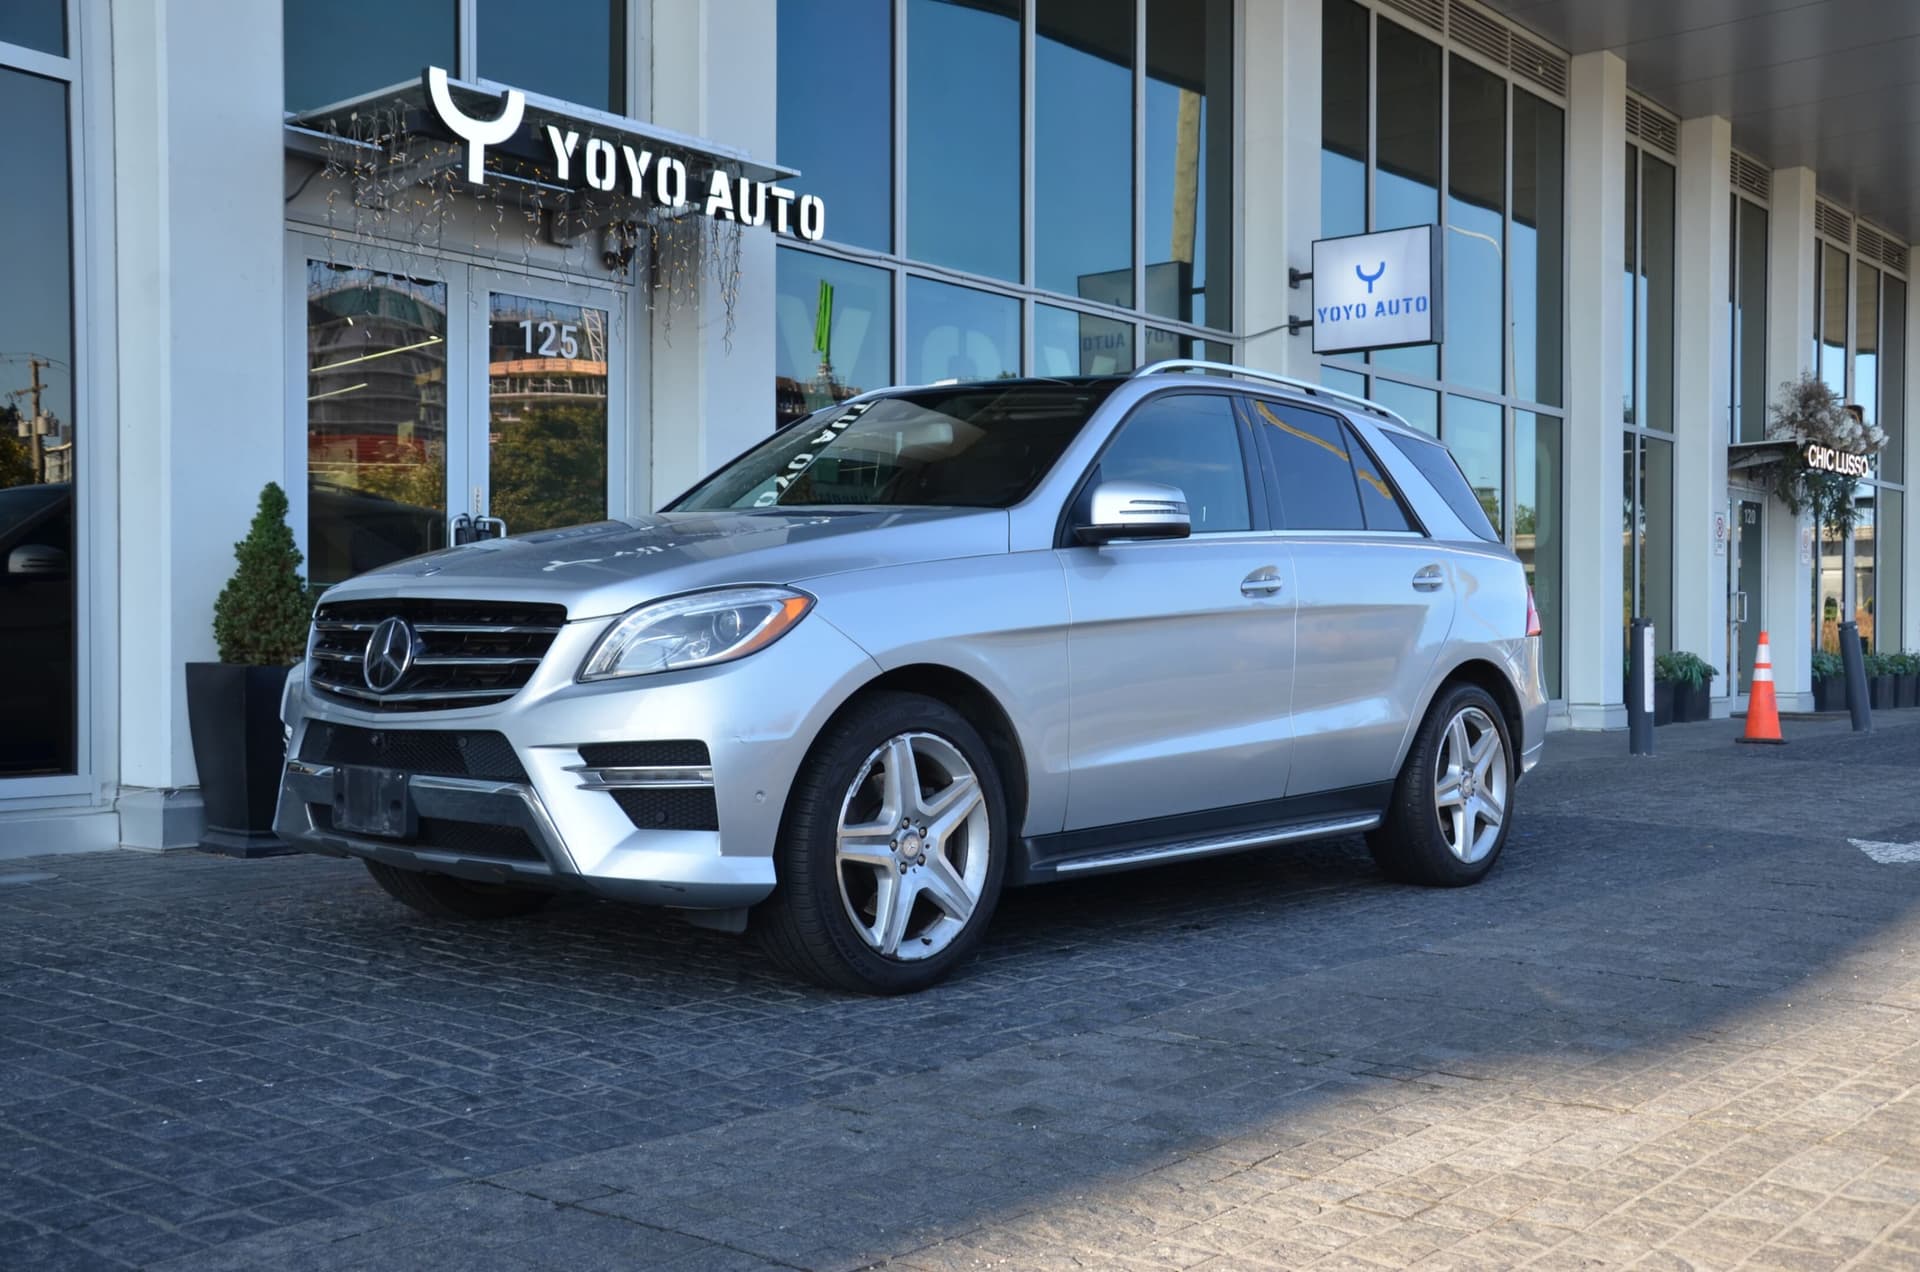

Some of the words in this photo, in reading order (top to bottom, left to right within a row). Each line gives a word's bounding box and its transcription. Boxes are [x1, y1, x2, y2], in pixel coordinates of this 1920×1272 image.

[545, 124, 687, 208] YOYO
[705, 169, 825, 241] AUTO
[1317, 303, 1366, 323] YOYO
[1375, 296, 1427, 317] AUTO
[519, 319, 578, 359] 125
[1808, 444, 1834, 471] CHIC
[1836, 450, 1868, 477] LUSSO
